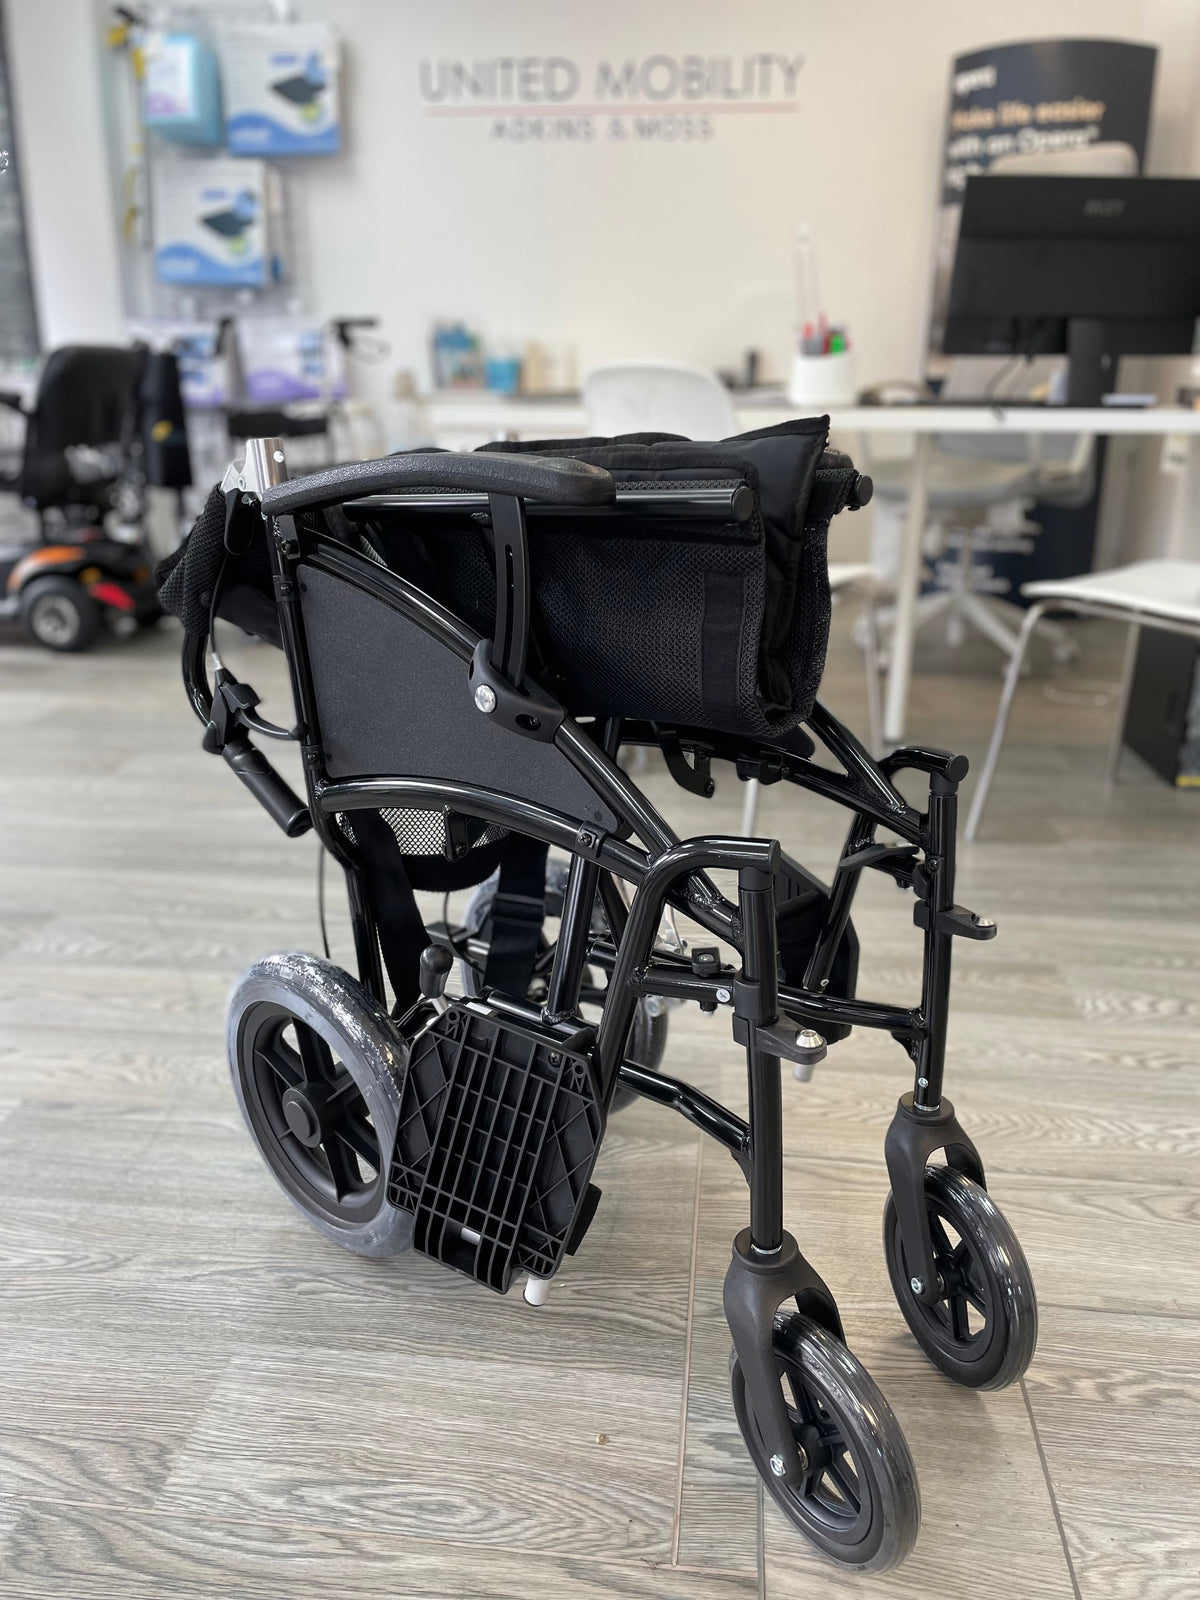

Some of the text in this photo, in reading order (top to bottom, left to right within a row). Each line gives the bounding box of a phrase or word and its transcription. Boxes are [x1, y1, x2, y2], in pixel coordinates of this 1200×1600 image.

[418, 53, 806, 103] UNITED MOBILITY
[998, 100, 1032, 126] life
[1035, 97, 1104, 123] easier
[489, 116, 597, 143] ADKINS
[631, 115, 716, 142] MOSS
[986, 134, 1014, 155] an
